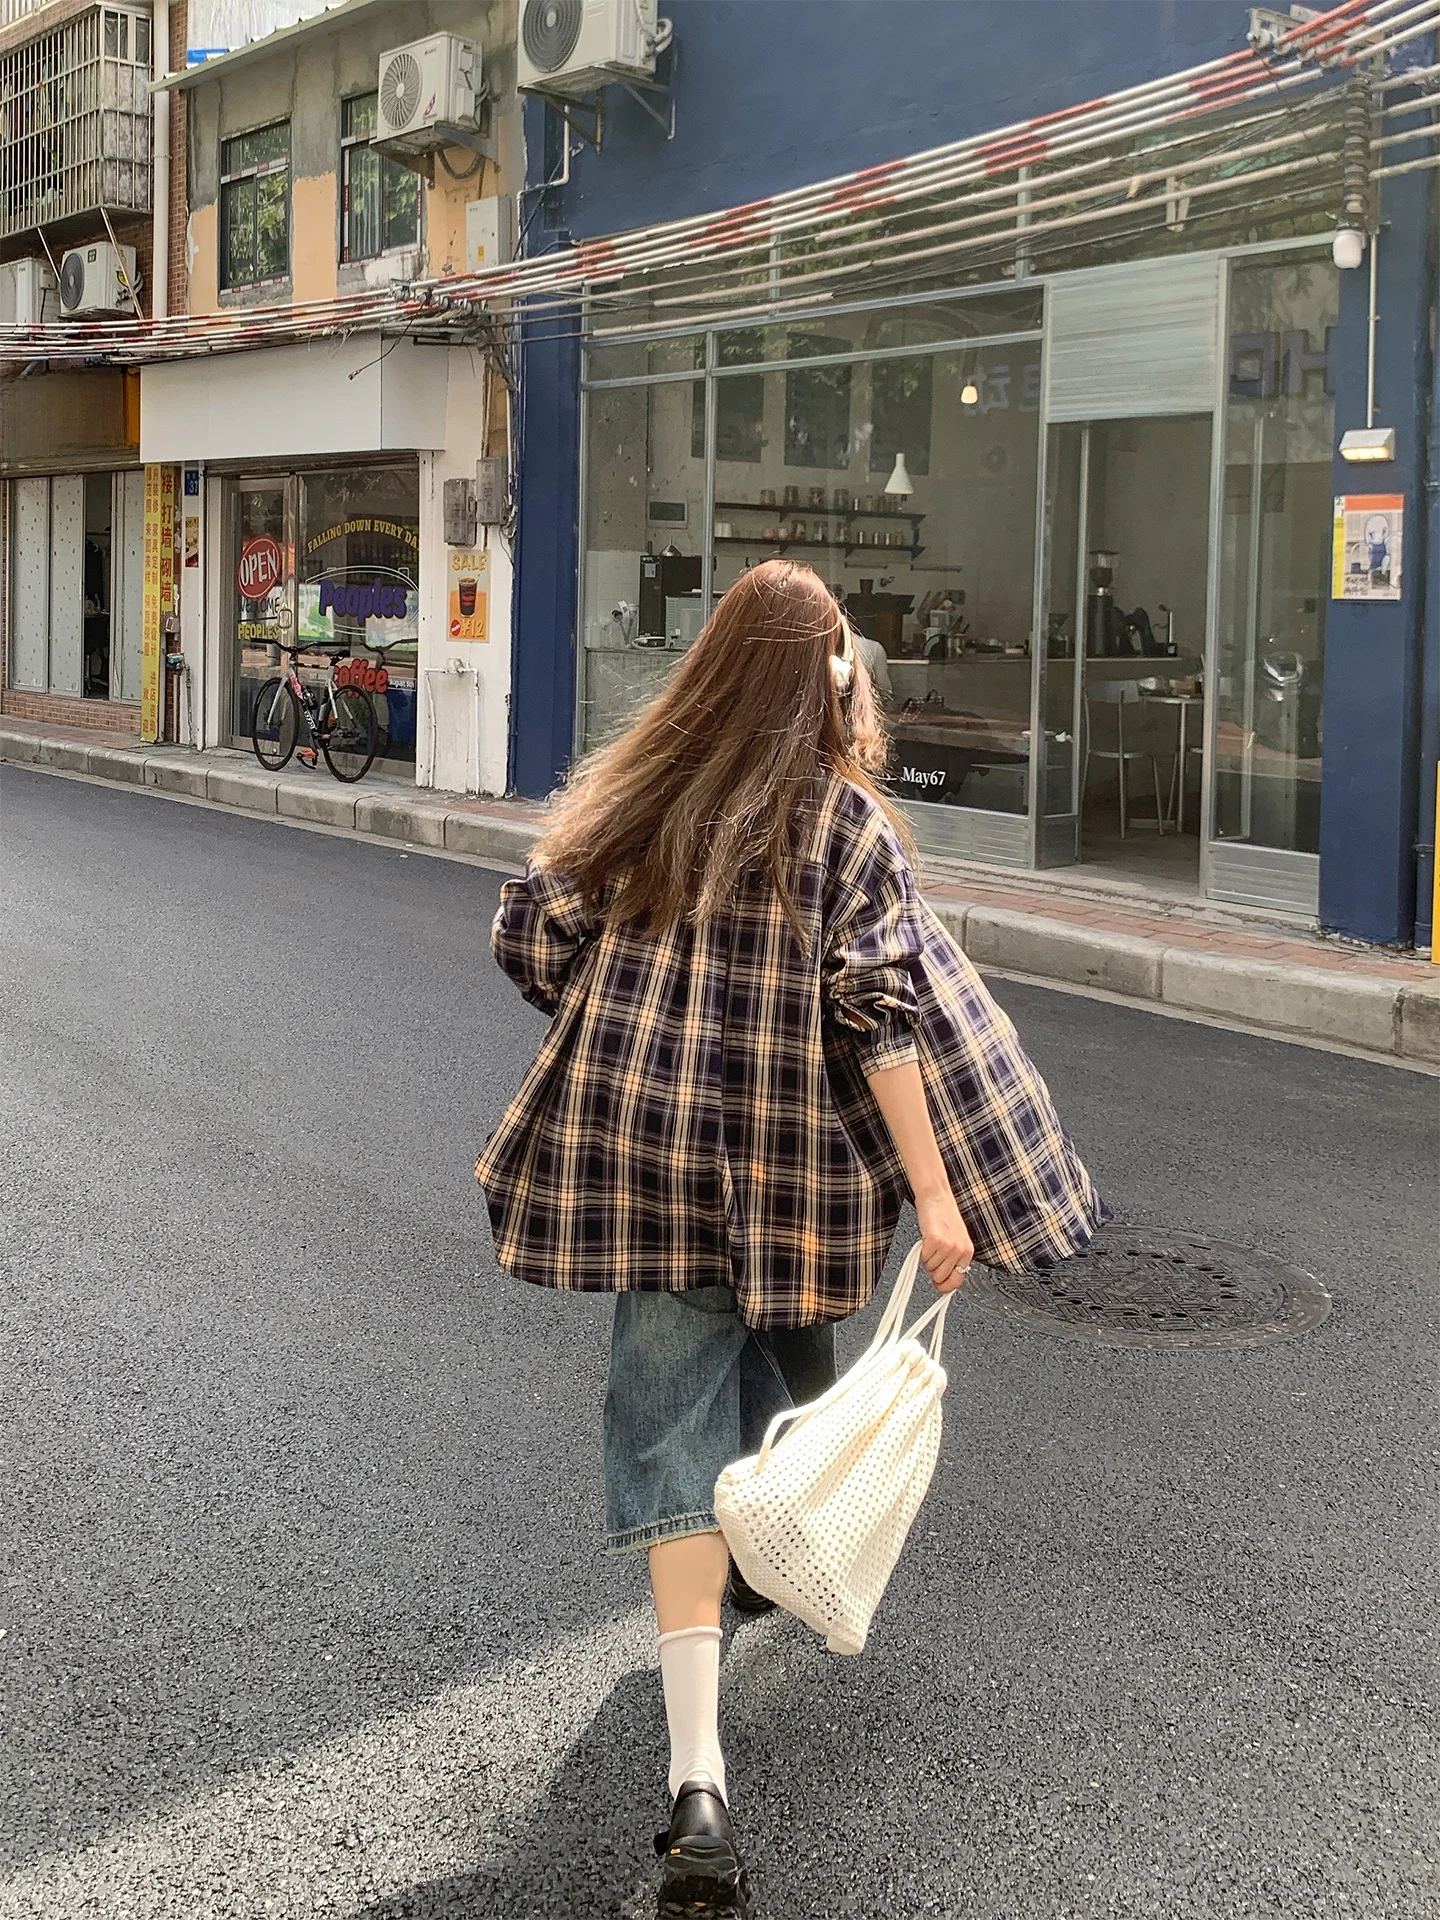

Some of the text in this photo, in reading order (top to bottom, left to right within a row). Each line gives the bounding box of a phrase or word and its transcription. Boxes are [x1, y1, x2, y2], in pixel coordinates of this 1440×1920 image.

[307, 519, 420, 554] FALLING DOWN EVERY DA
[240, 548, 278, 587] OPEN
[451, 554, 487, 571] SALE
[319, 577, 408, 627] Peoples
[238, 623, 280, 640] PEOPLES
[462, 619, 485, 638] ¥12
[902, 766, 946, 788] May67
